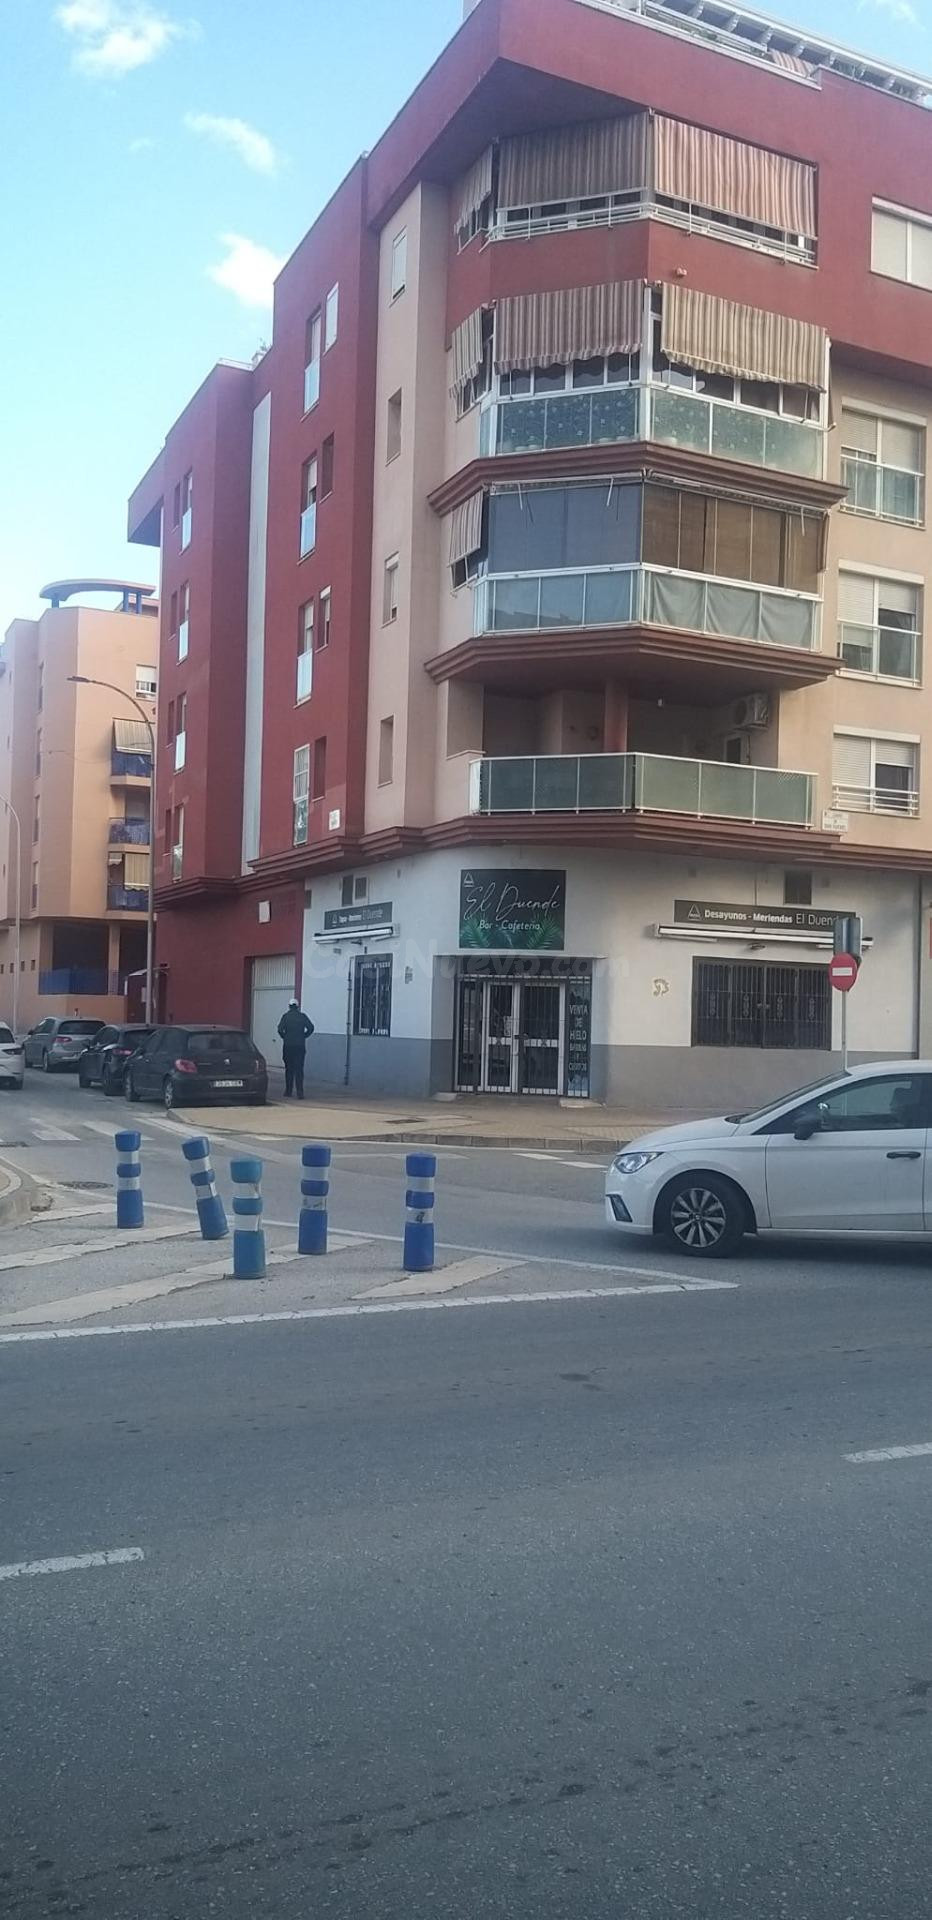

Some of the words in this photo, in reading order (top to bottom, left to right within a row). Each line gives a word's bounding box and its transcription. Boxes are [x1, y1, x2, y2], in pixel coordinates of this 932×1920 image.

[463, 882, 496, 920] El
[496, 883, 560, 921] Duende
[704, 909, 748, 921] Desayunos
[753, 913, 793, 924] Meriendas
[796, 913, 805, 924] El
[808, 914, 839, 926] Duen
[480, 919, 493, 929] Bar
[569, 1004, 588, 1015] VENTA
[569, 1030, 587, 1041] HELO
